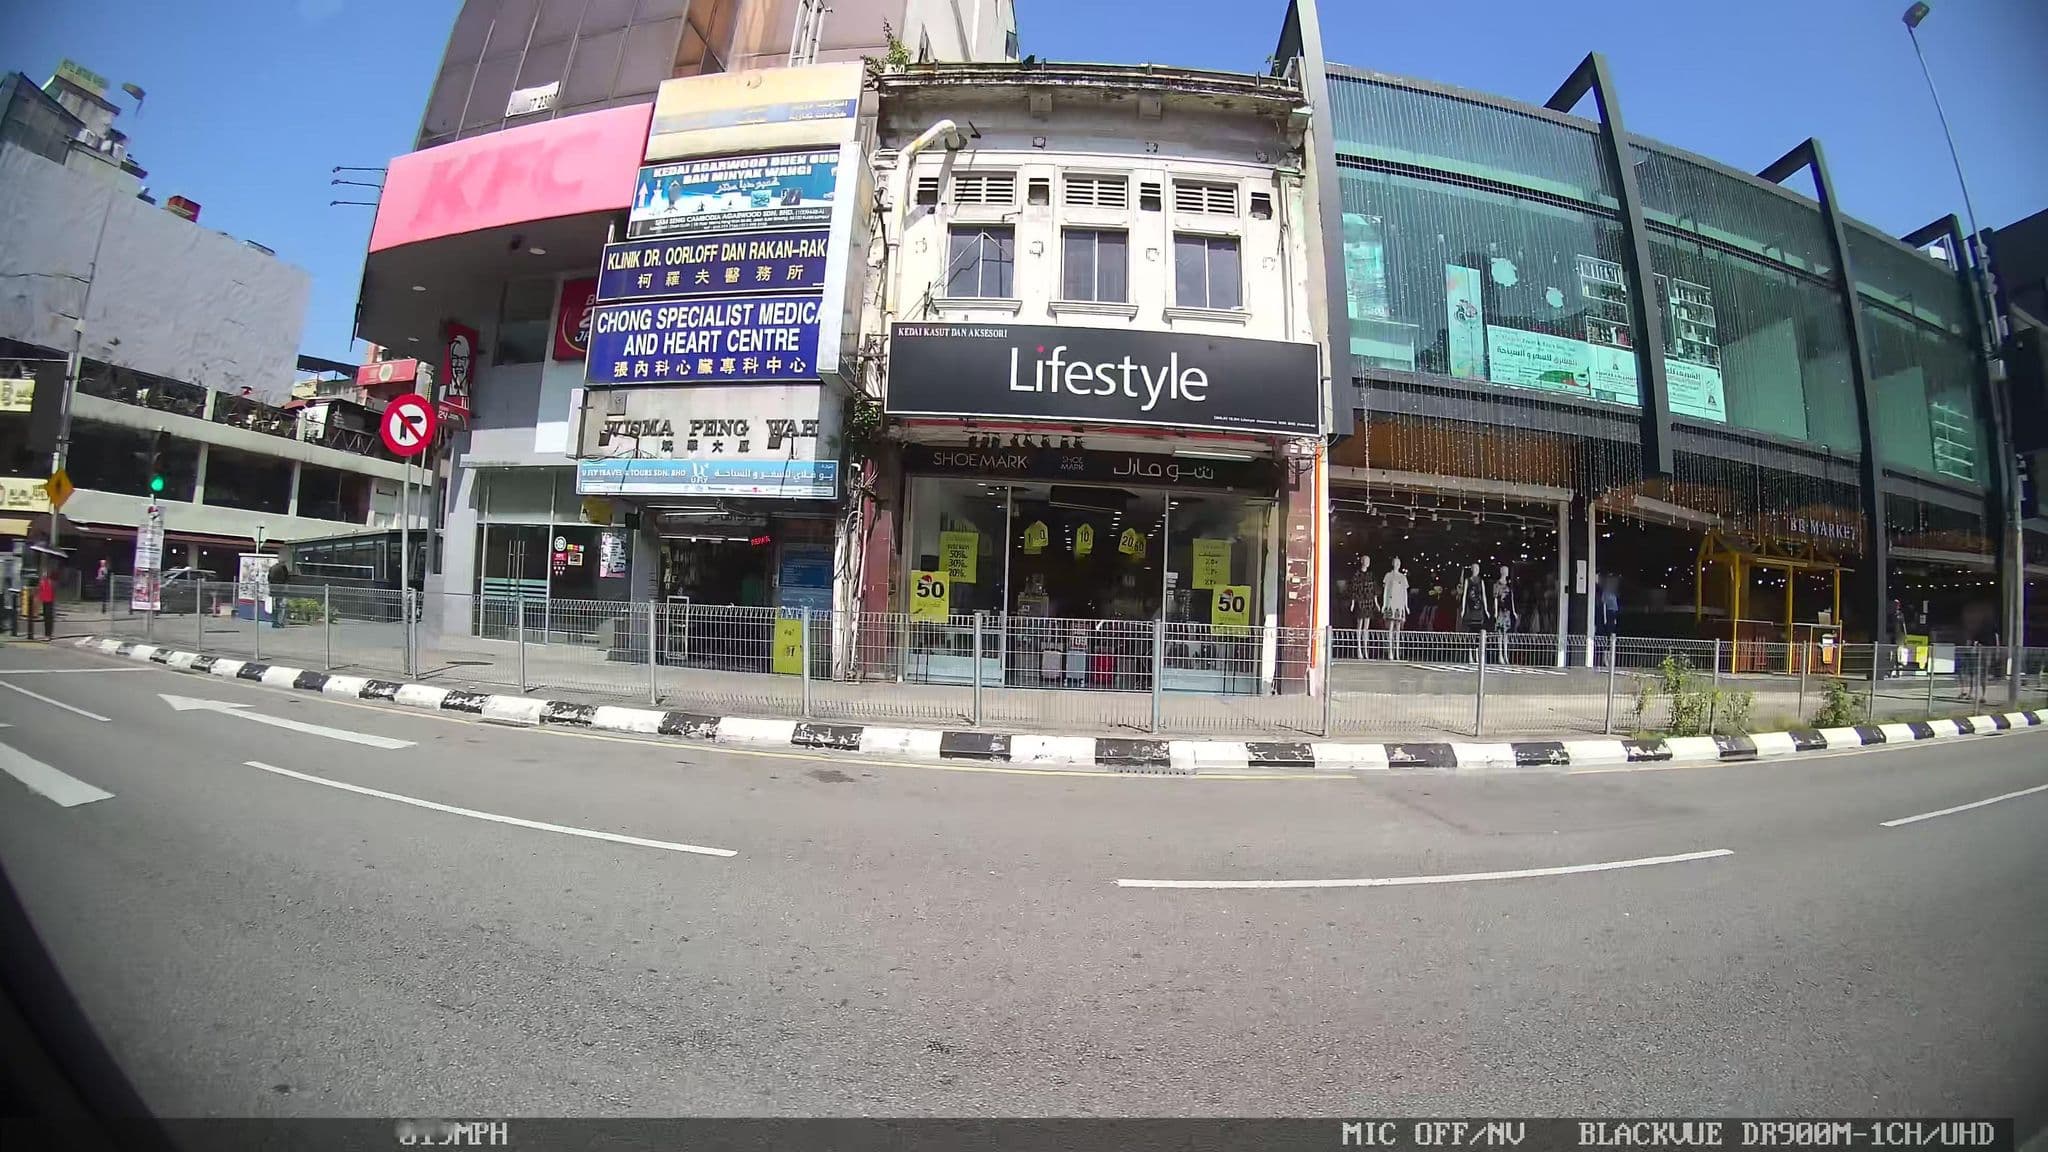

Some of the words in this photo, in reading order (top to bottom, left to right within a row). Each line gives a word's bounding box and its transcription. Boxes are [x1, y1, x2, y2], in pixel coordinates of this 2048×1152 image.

[653, 165, 690, 178] KEDAI
[691, 157, 769, 174] AGARWOOD
[711, 168, 762, 182] MINYAK
[764, 165, 812, 178] WANGI
[410, 129, 603, 230] KFC
[721, 211, 762, 220] AGARWOOD
[607, 250, 641, 271] KLINIK
[643, 248, 661, 268] DR.
[665, 244, 719, 265] OORLOFF
[721, 242, 747, 262] DAN
[597, 308, 652, 334] CHONG
[656, 303, 754, 330] SPECIALIST
[623, 333, 658, 357] AND
[663, 330, 722, 355] HEART
[727, 328, 801, 352] CENTRE
[898, 327, 922, 337] KEDAI
[923, 327, 950, 337] KASUT
[951, 328, 967, 338] DAN
[968, 328, 1008, 339] AKSESORI
[1009, 344, 1209, 412] Lifestyle
[604, 419, 674, 438] WISMA
[689, 418, 750, 438] PENG
[766, 418, 820, 438] WAH
[1060, 463, 1085, 471] MARK
[1062, 455, 1084, 464] SHOE
[599, 469, 623, 477] TRAVEL
[631, 469, 653, 477] TOURS
[916, 579, 945, 598] 50
[1218, 596, 1245, 613] 50
